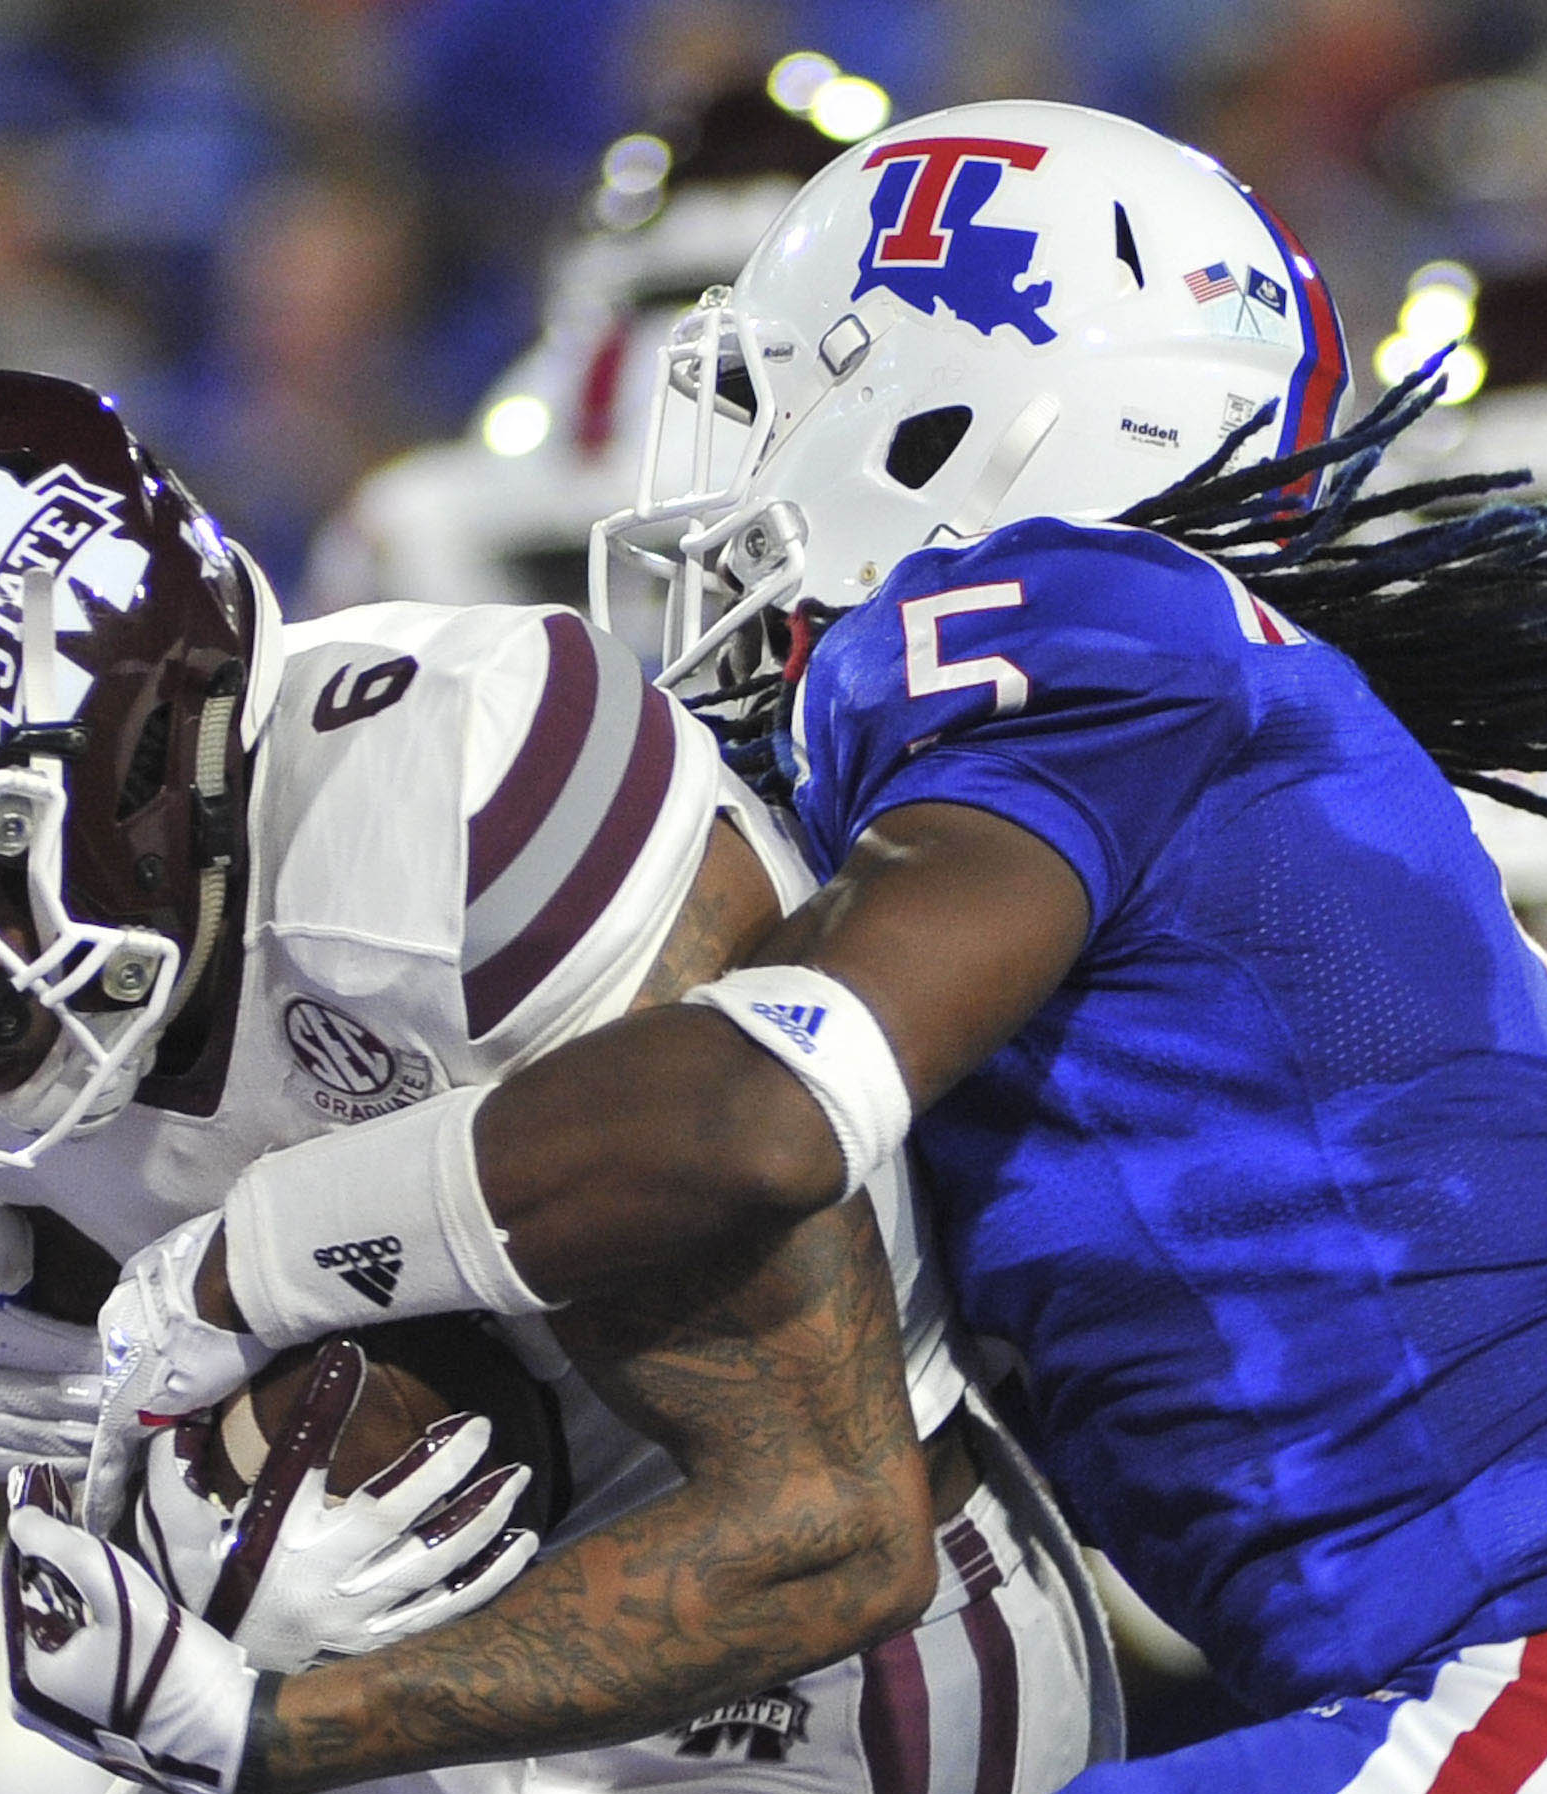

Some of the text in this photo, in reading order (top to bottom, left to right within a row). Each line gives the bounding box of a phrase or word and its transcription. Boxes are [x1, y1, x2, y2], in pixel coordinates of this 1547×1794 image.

[1120, 418, 1179, 442] Riddell
[314, 654, 418, 733] 6
[902, 582, 1029, 755] 5
[287, 1003, 391, 1092] SEC
[750, 1002, 818, 1055] adidas
[314, 1074, 426, 1121] GRADUATE
[313, 1235, 403, 1270] adidas
